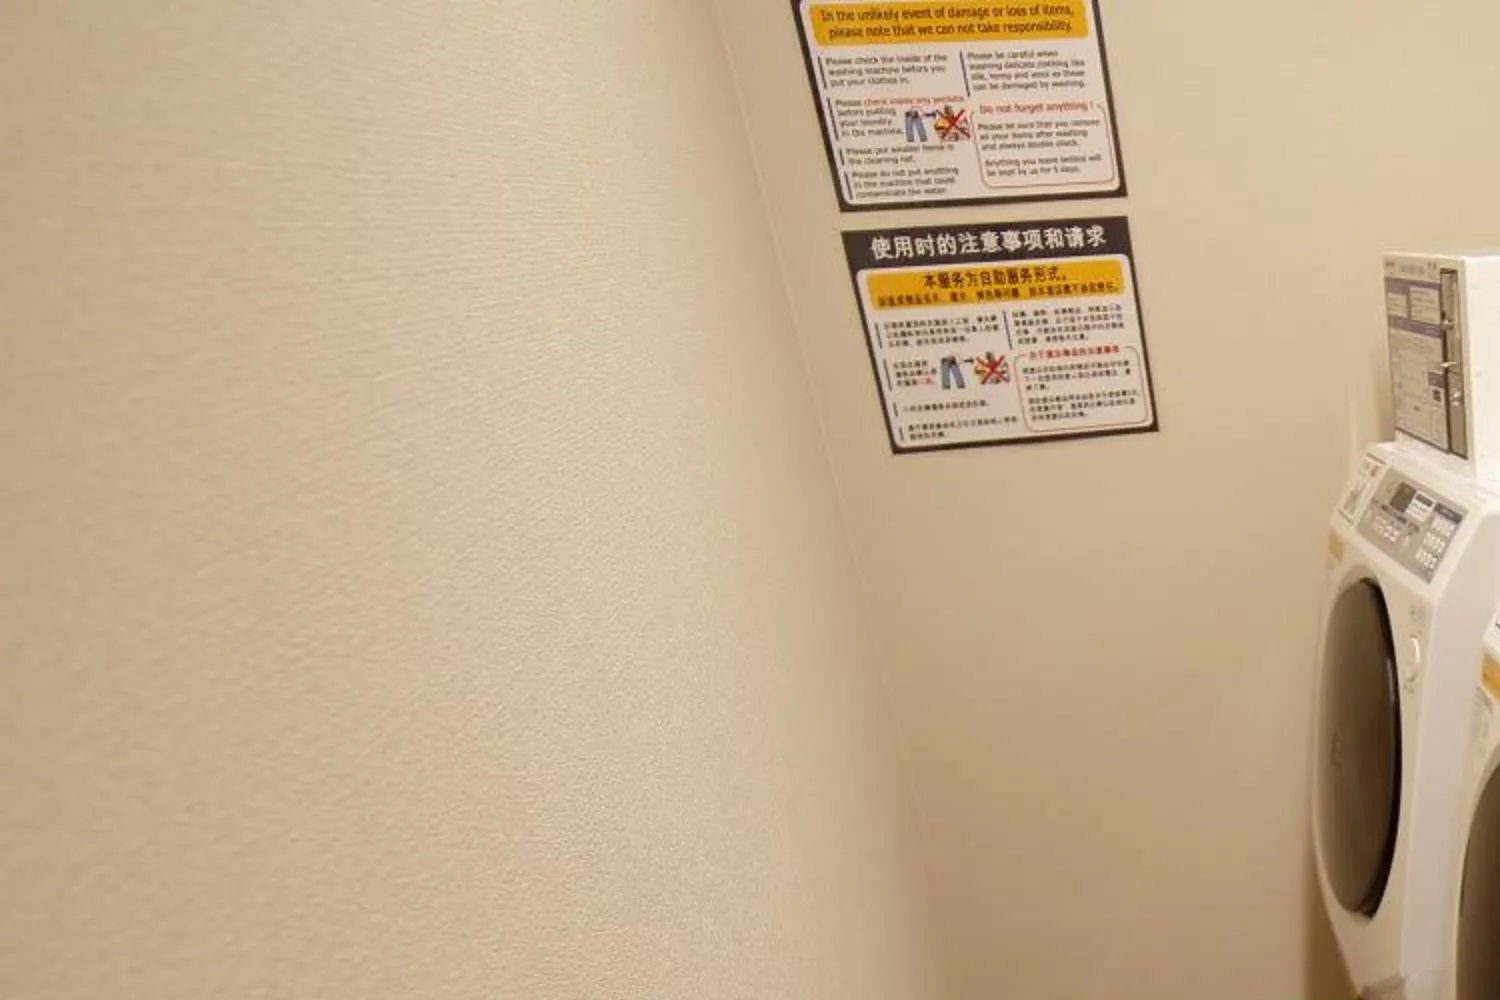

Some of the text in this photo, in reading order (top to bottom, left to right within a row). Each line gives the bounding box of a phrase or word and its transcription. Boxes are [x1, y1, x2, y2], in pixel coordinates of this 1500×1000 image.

[821, 10, 832, 22] In
[836, 10, 855, 22] the
[858, 9, 899, 21] unlikely
[903, 9, 933, 19] event
[936, 8, 945, 19] of
[948, 7, 990, 19] damage
[992, 7, 1004, 16] or
[1006, 5, 1026, 16] loss
[1029, 5, 1041, 15] of
[829, 27, 862, 40] please
[866, 26, 890, 37] note
[892, 25, 915, 36] that
[918, 26, 933, 35] we
[936, 26, 953, 35] can
[958, 23, 974, 33] not
[977, 21, 1000, 33] take
[855, 56, 879, 64] check
[1008, 50, 1034, 58] careful
[902, 65, 929, 73] before
[931, 66, 946, 74] you
[996, 104, 1011, 112] not
[1014, 103, 1043, 114] forget
[1046, 102, 1088, 112] anything
[871, 225, 1107, 260] 使用时的注意事项和请求
